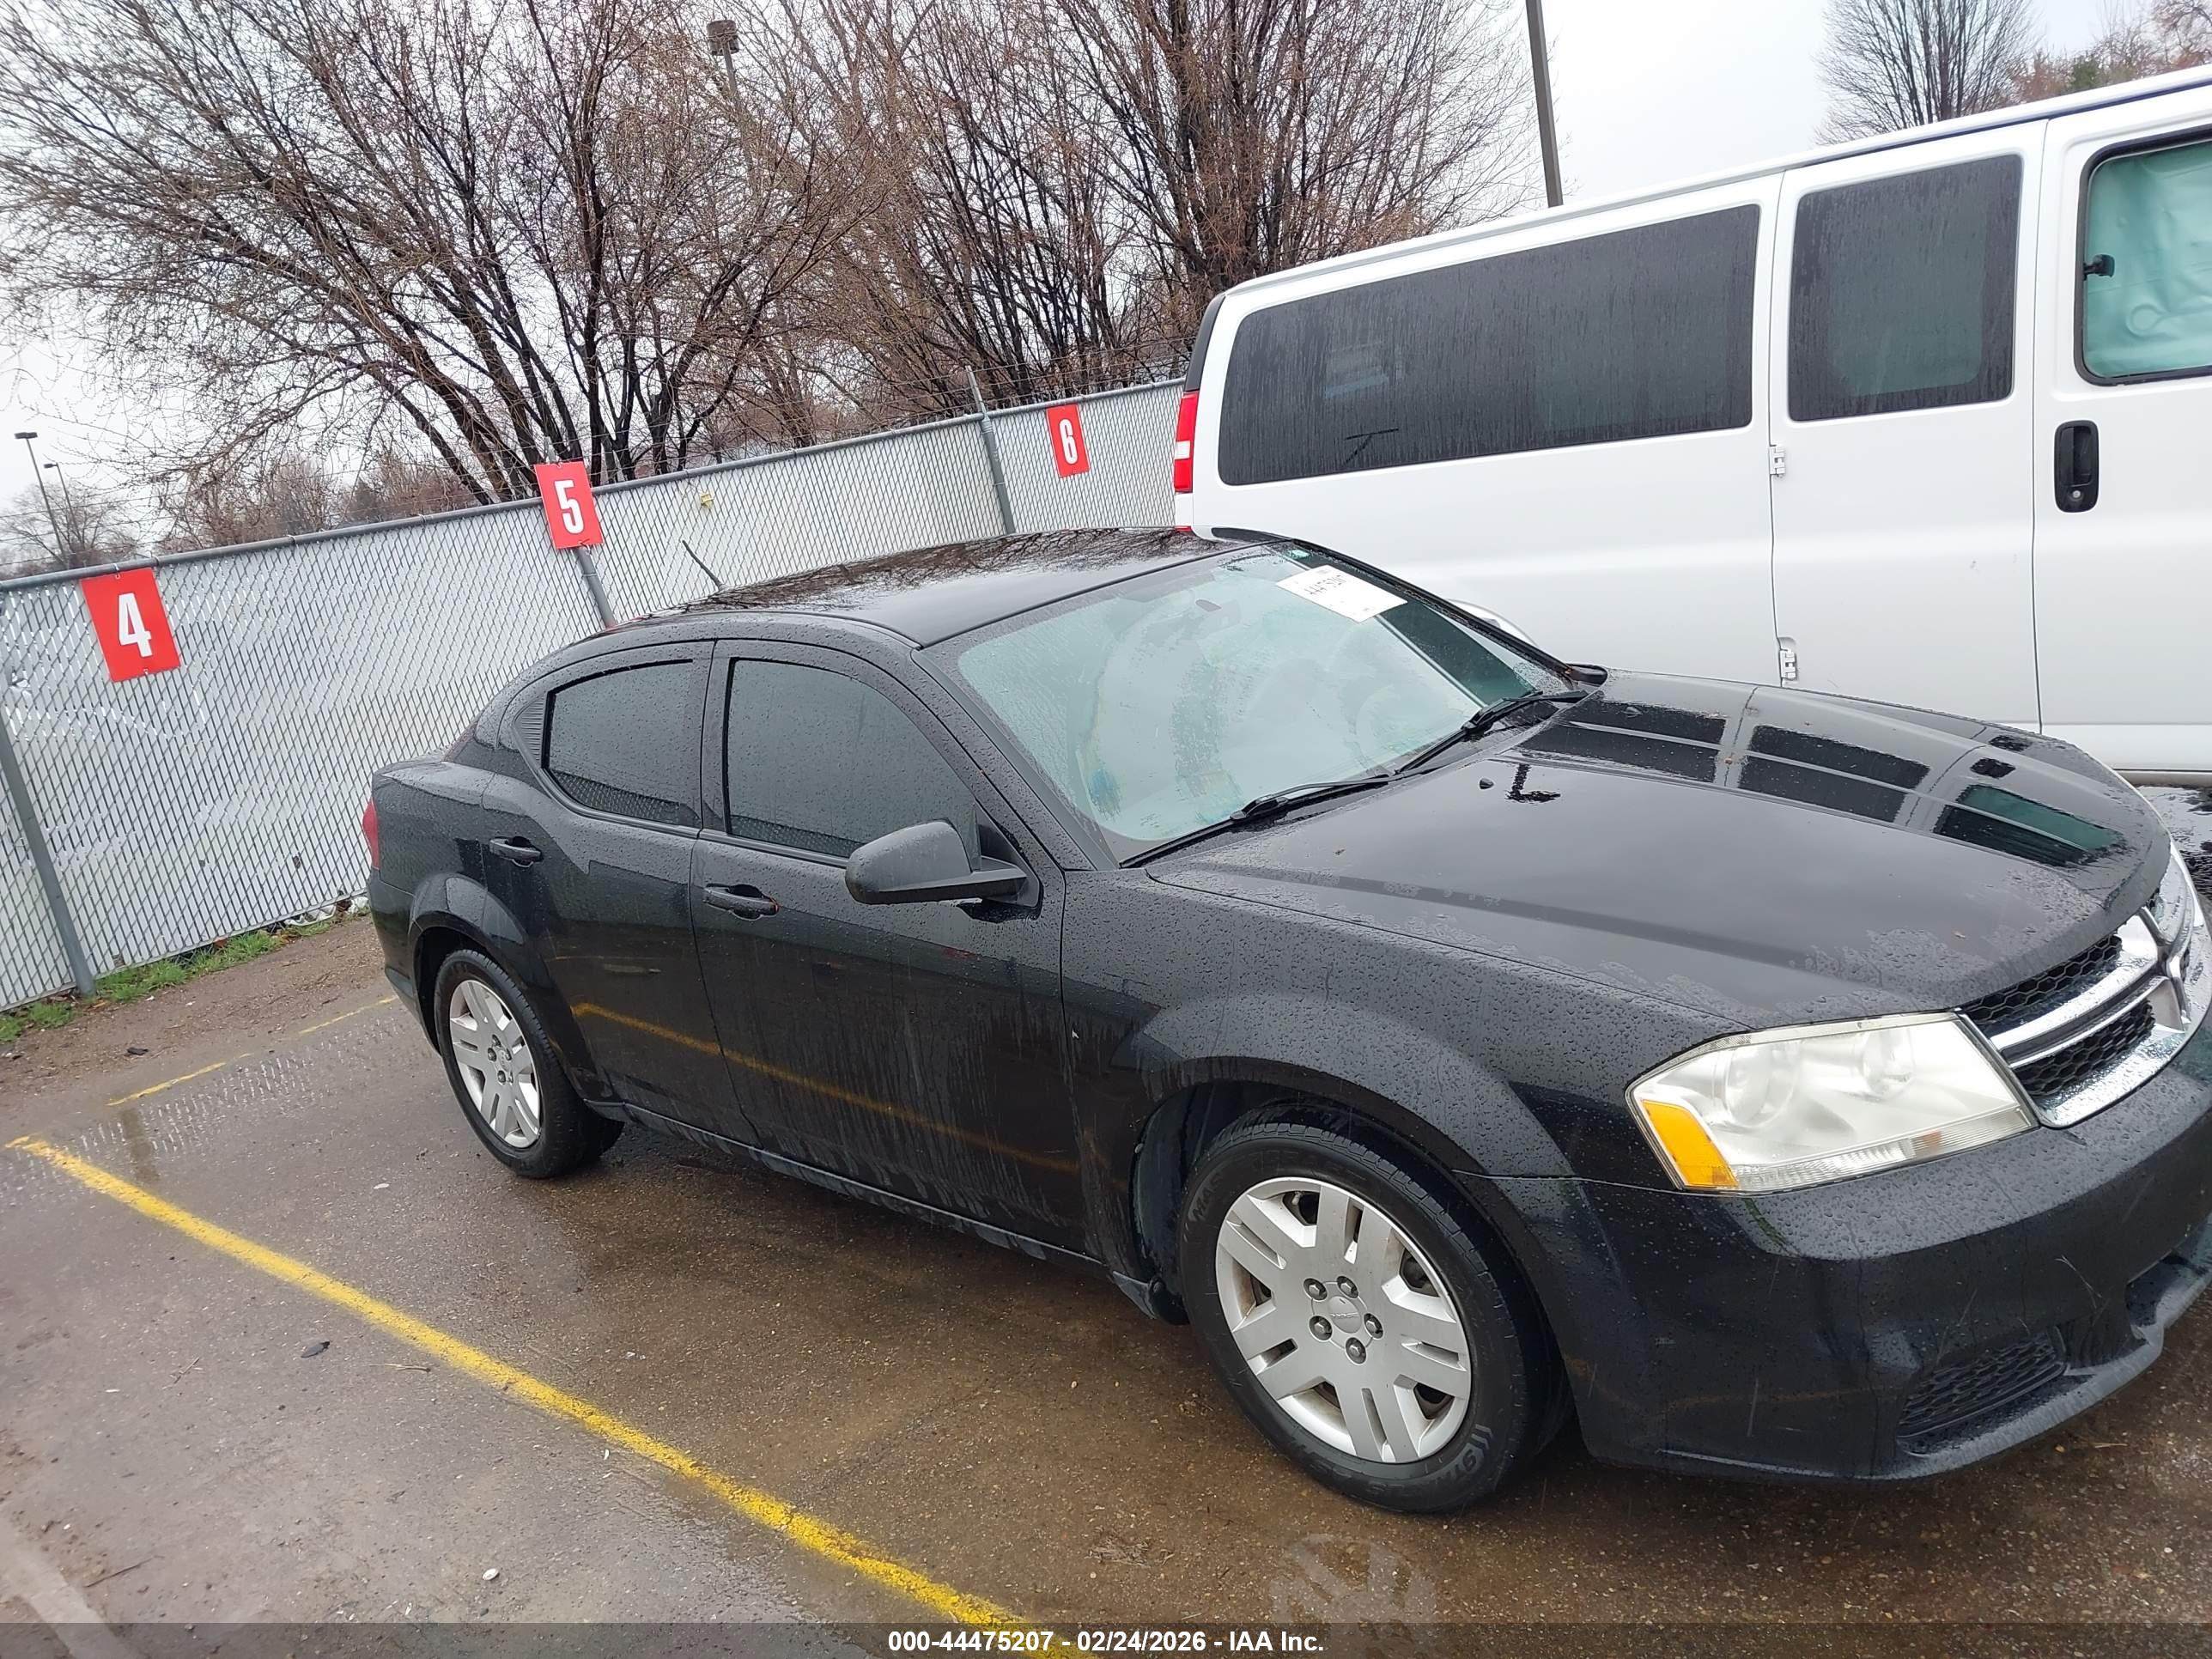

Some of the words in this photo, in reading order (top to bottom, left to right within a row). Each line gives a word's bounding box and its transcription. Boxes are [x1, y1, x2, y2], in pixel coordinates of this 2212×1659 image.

[1060, 419, 1078, 464] 6
[555, 480, 584, 534] 5
[119, 592, 152, 657] 4
